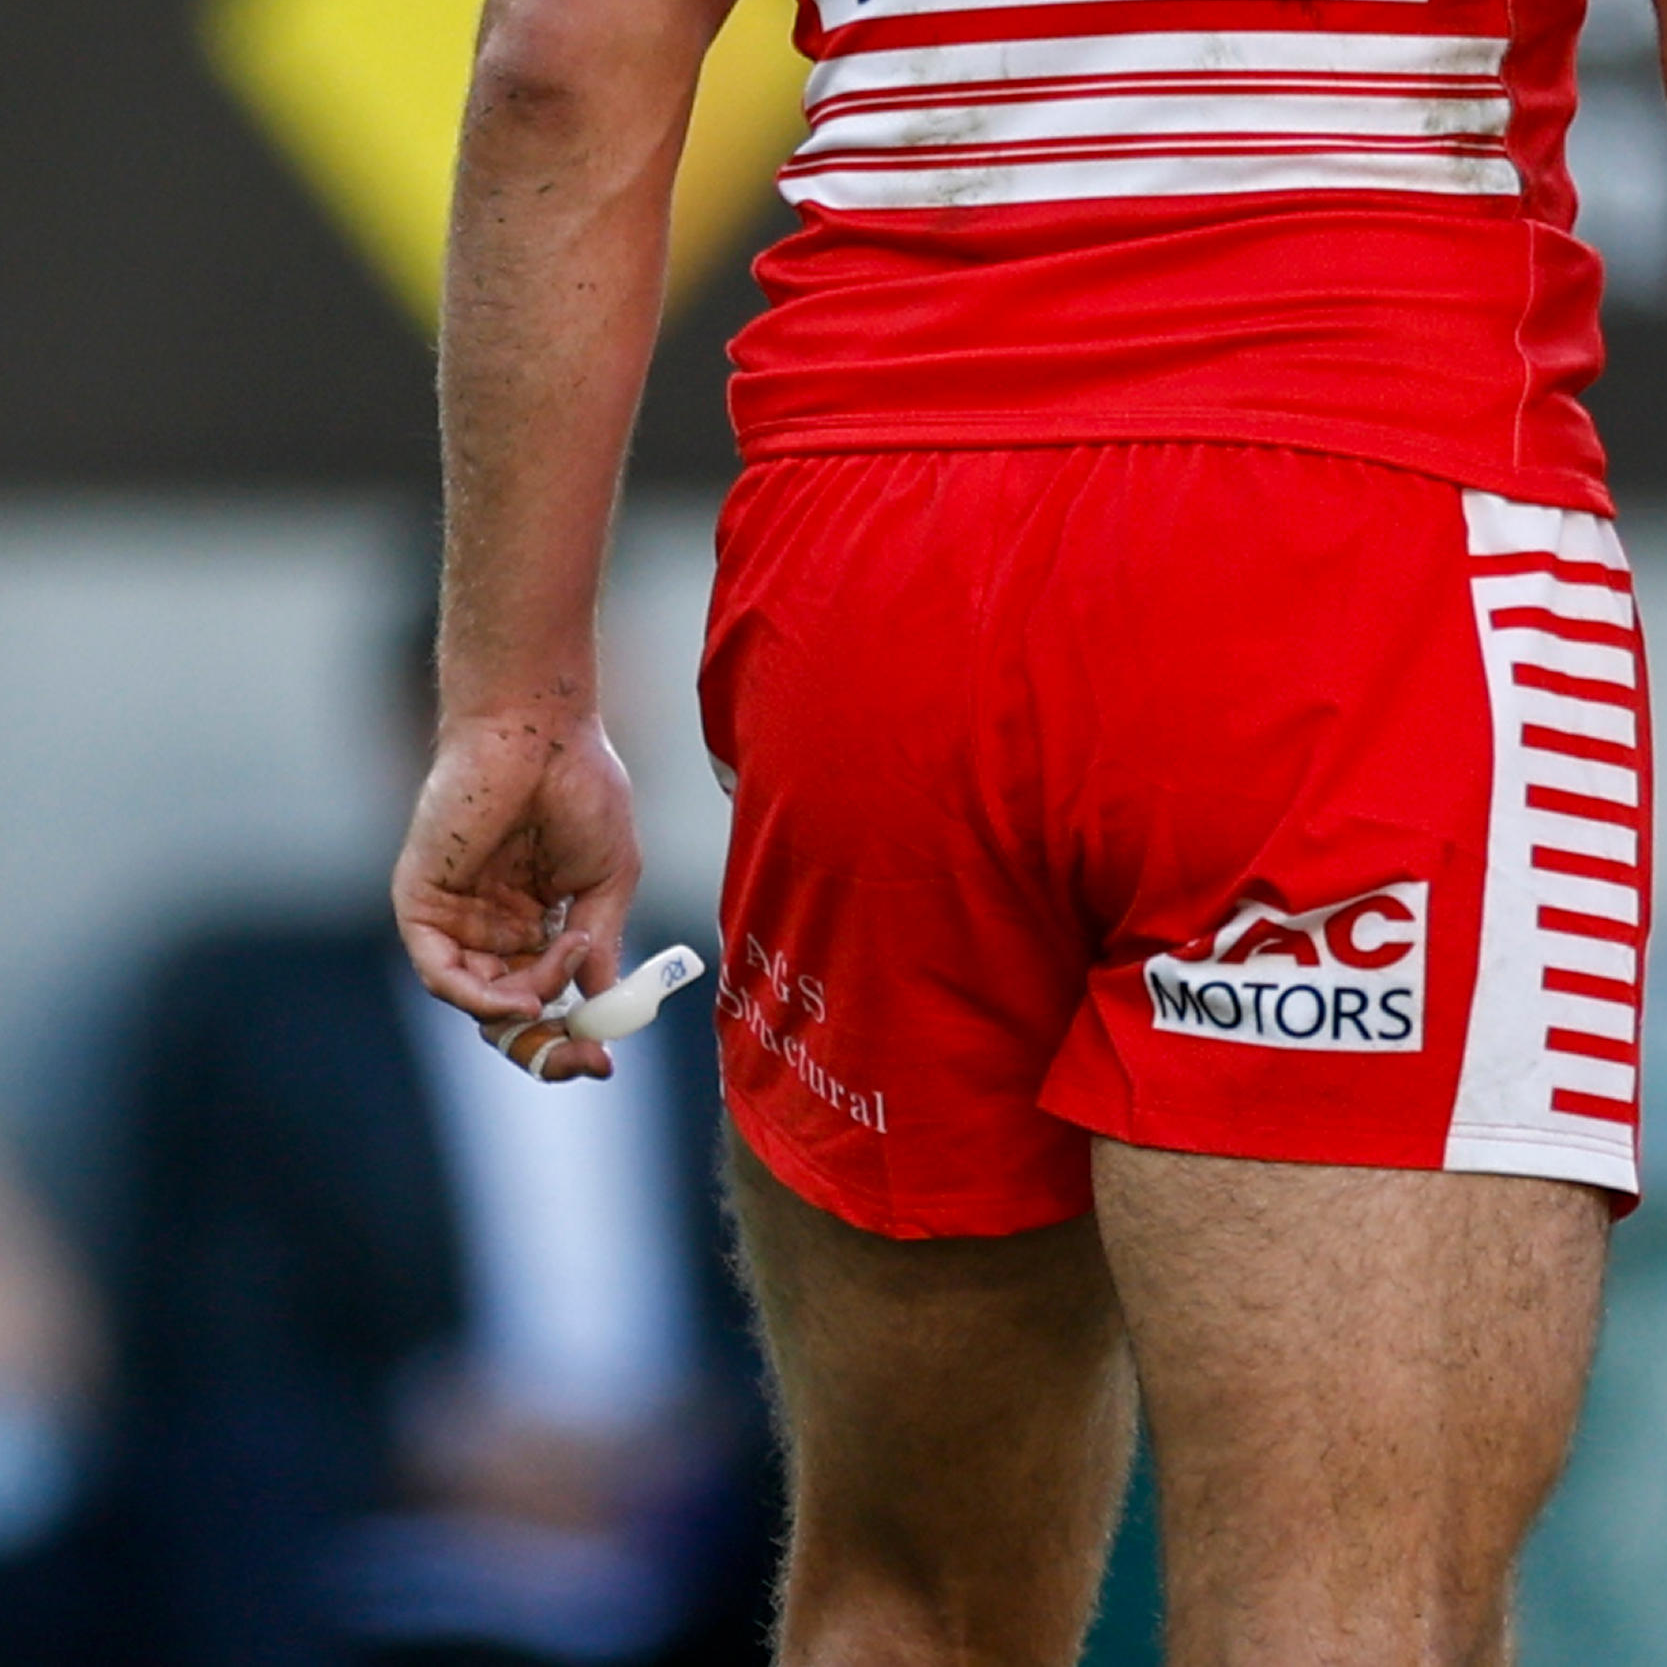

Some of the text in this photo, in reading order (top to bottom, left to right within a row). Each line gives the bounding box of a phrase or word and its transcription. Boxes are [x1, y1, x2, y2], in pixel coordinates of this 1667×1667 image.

[1172, 893, 1416, 971] AC
[745, 931, 827, 1024] AGS
[1150, 971, 1414, 1042] MOTORS
